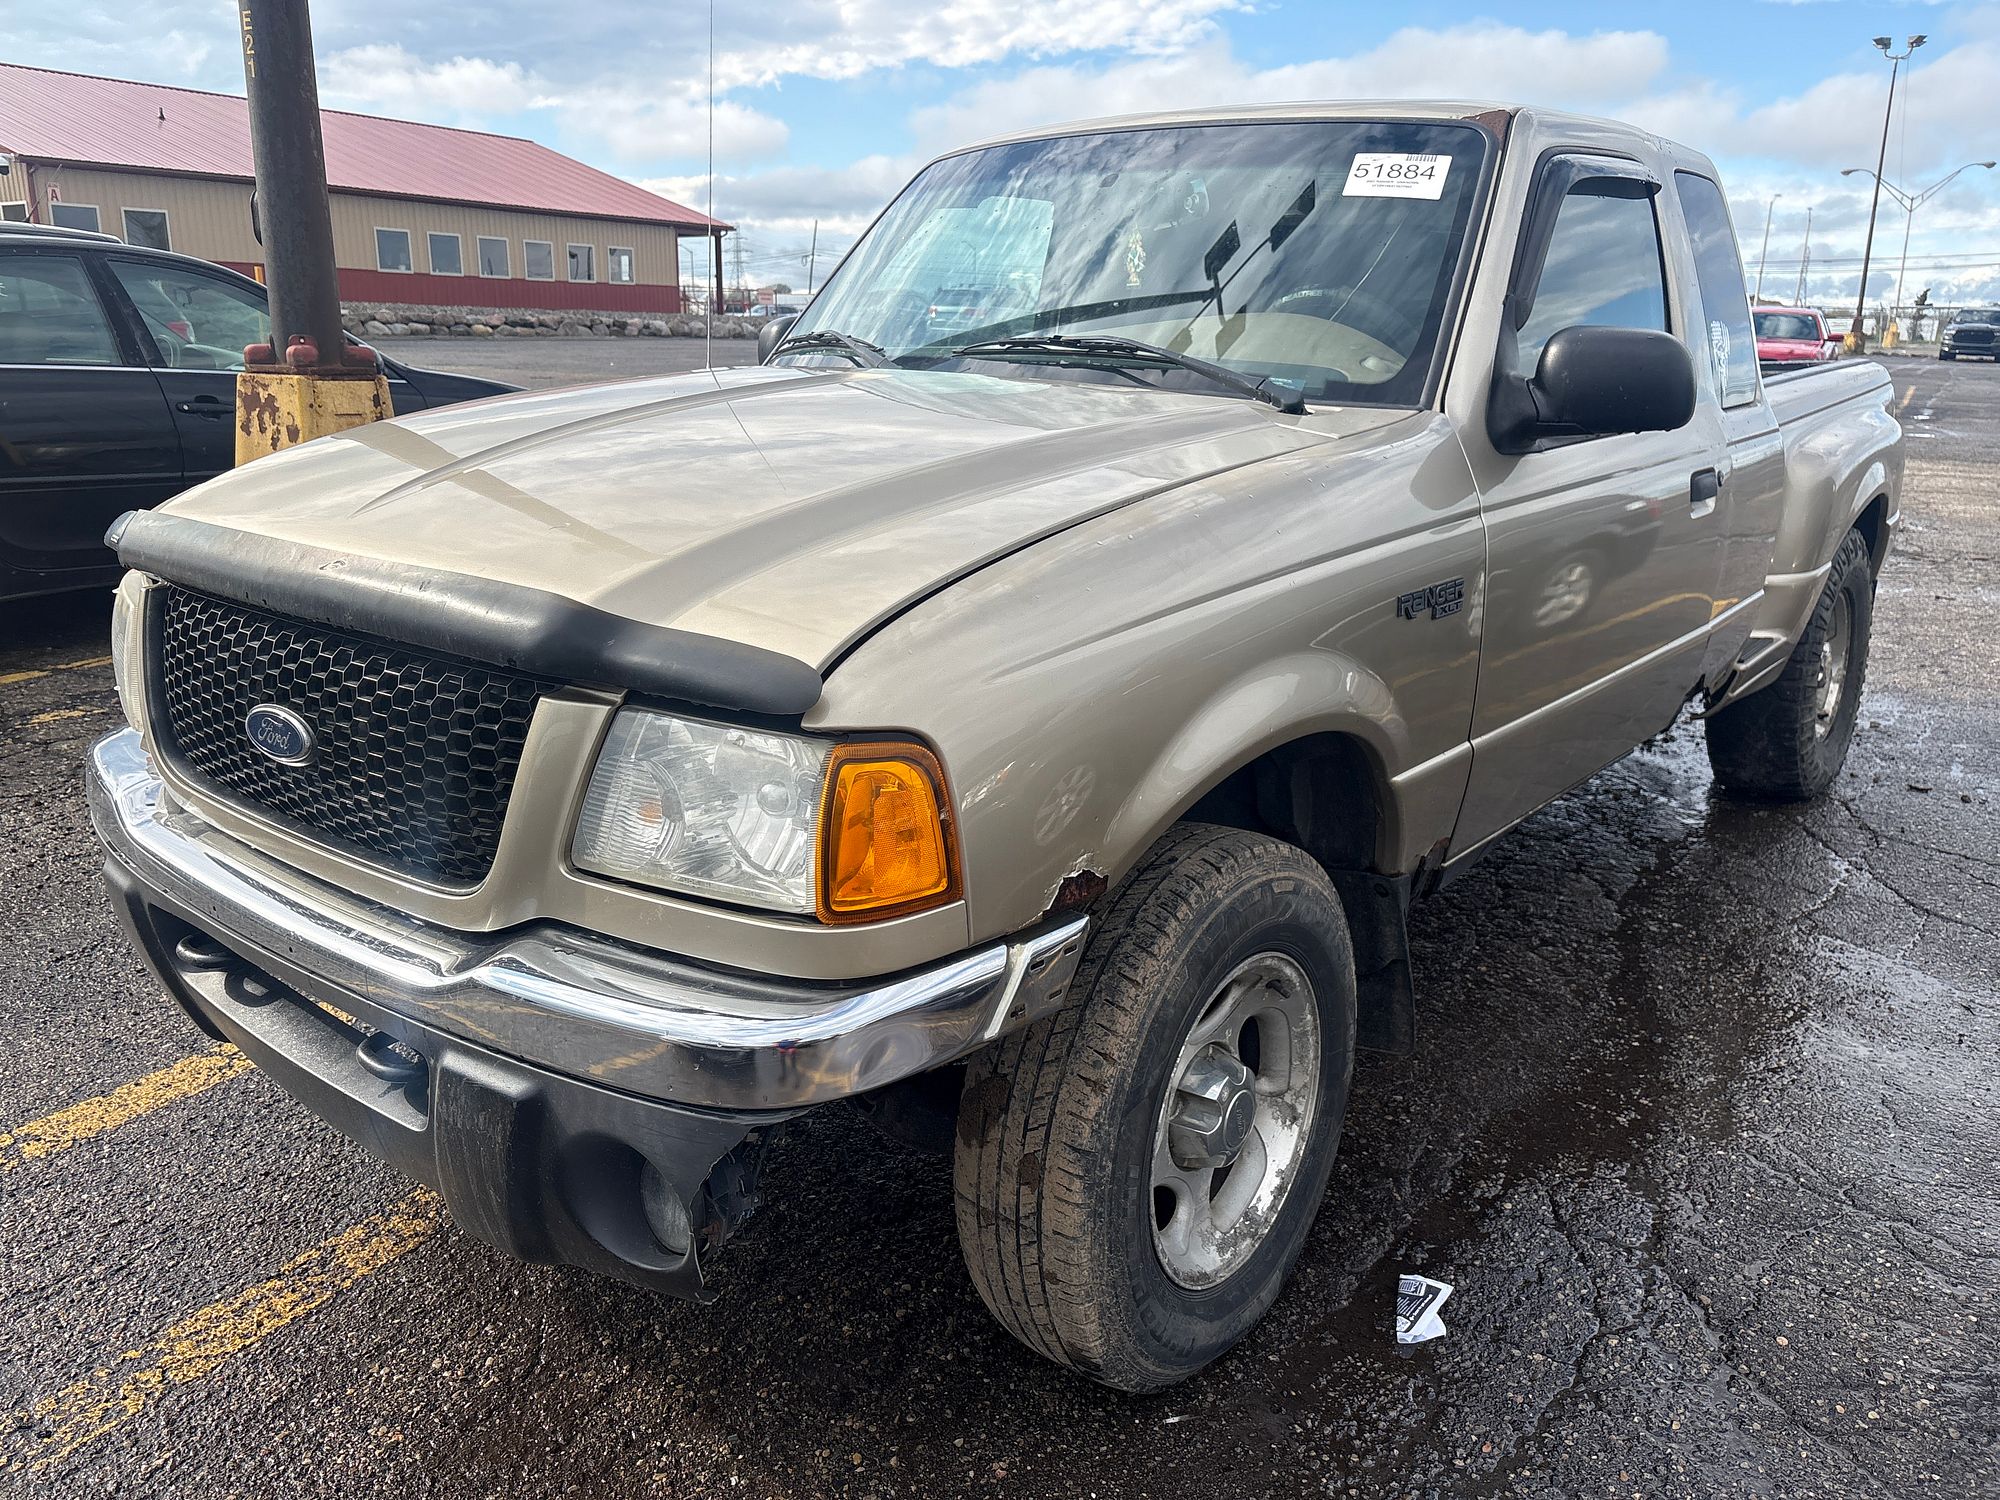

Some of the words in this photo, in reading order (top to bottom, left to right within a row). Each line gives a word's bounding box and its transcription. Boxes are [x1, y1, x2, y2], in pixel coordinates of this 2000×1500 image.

[241, 10, 256, 78] E21
[1353, 163, 1436, 180] 51884
[1396, 577, 1464, 620] RANGER
[1440, 600, 1463, 616] XLT
[257, 717, 292, 750] Ford
